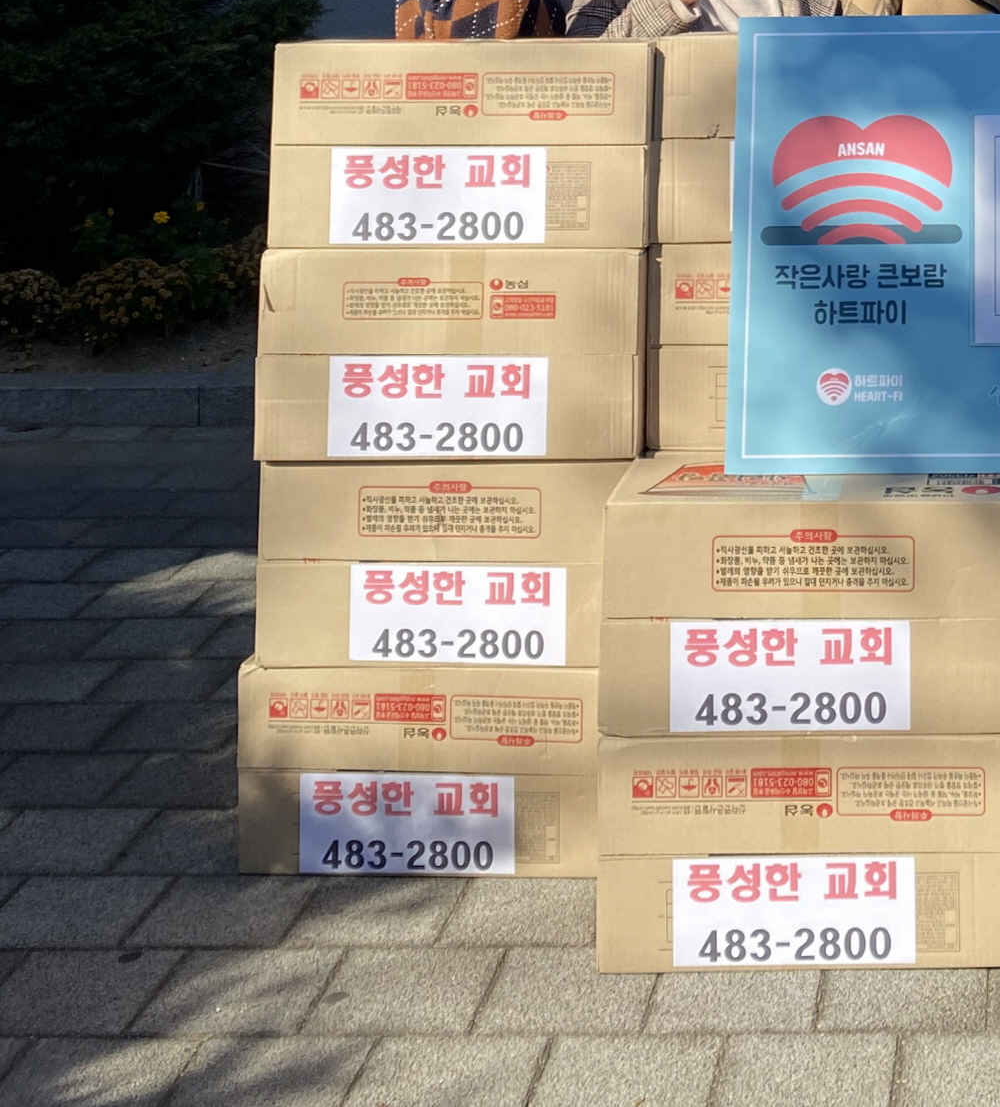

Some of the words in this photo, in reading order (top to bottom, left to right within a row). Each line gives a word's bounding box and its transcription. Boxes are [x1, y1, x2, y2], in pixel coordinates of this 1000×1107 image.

[407, 81, 462, 90] 080-023-5181
[435, 105, 461, 116] 농심
[837, 142, 885, 157] ANSAN
[345, 155, 445, 189] 풍성한
[466, 155, 529, 187] 교회
[352, 211, 524, 241] 483-2800
[505, 279, 528, 289] 농심
[774, 264, 870, 290] 작은사랑
[877, 263, 947, 289] 큰보람
[813, 300, 906, 325] 하트파이
[343, 364, 445, 398] 풍성한
[465, 364, 530, 399] 교회
[854, 374, 903, 388] 하트파이
[854, 390, 903, 402] HEART-FI
[350, 422, 523, 451] 483-2800
[433, 483, 467, 492] 주의사항
[794, 531, 832, 541] 주의사항
[364, 572, 465, 605] 풍성한
[486, 572, 550, 606] 교회
[372, 629, 544, 659] 483-2800
[685, 628, 798, 667] 풍성한
[821, 628, 892, 665] 교회
[376, 702, 430, 712] 080-023-5181
[695, 692, 886, 726] 483-2800
[403, 728, 429, 739] 농심
[753, 777, 814, 786] 080-023-5181
[314, 781, 413, 815] 풍성한
[436, 783, 498, 816] 교회
[694, 804, 746, 814] 신라면큰사발면
[784, 804, 813, 817] 농심
[322, 839, 493, 868] 483-2800
[688, 865, 801, 902] 풍성한
[825, 865, 896, 899] 교회
[699, 927, 891, 960] 483-2800
